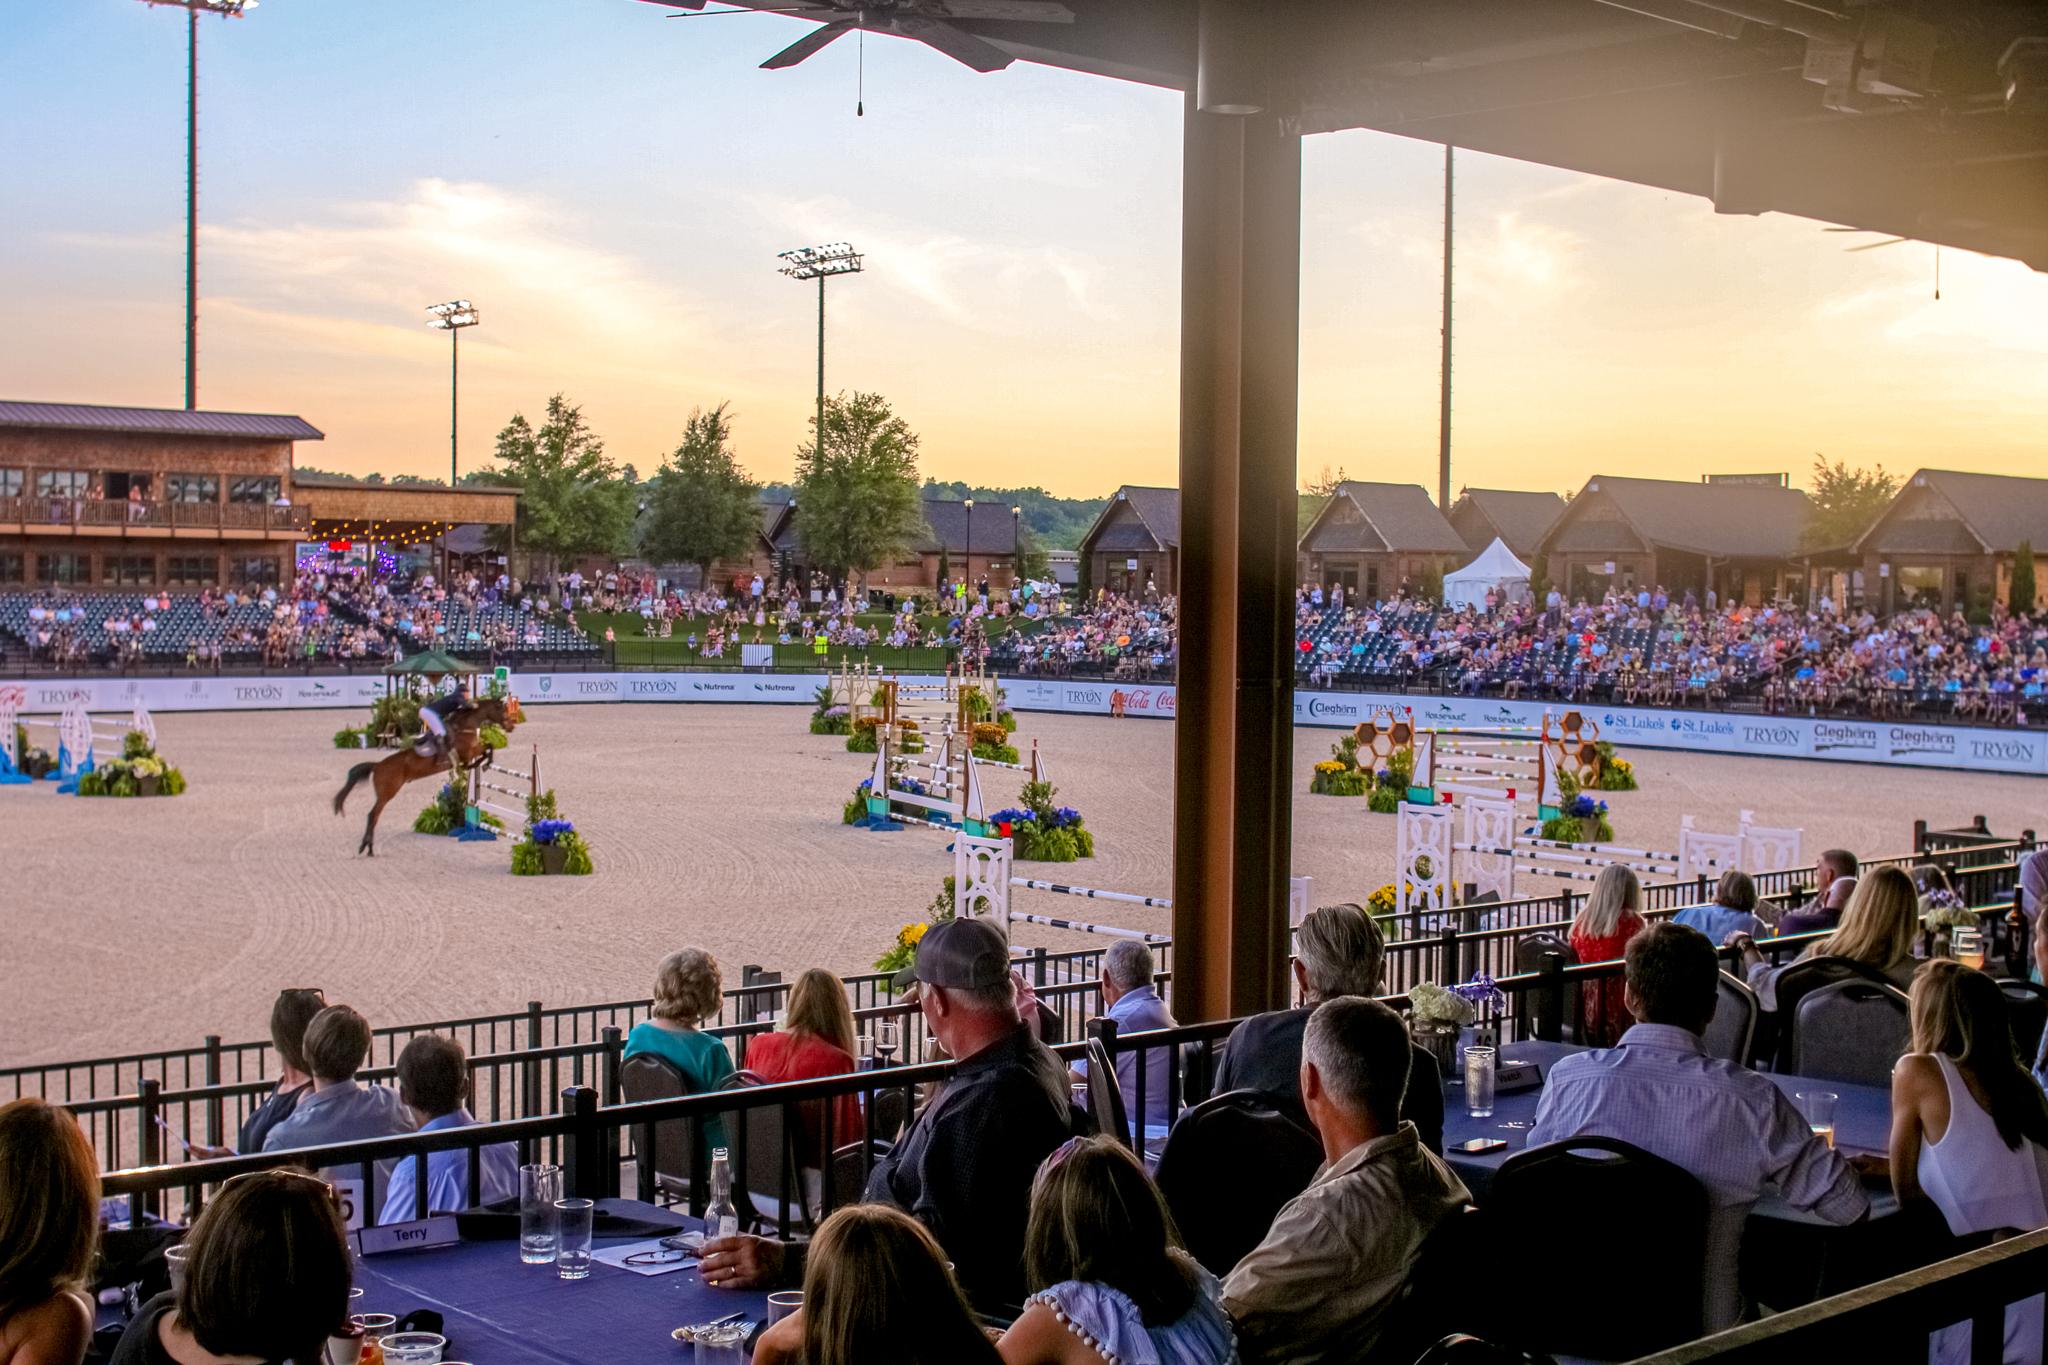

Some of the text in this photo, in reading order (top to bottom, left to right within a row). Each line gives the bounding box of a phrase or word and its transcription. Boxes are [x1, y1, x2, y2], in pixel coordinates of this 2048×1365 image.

[234, 685, 282, 699] TRYON
[577, 680, 617, 692] TRYON
[630, 680, 677, 692] TRYON
[704, 683, 735, 691] Nutrena
[764, 684, 796, 692] Nutrena
[38, 688, 92, 703] TRYON
[1066, 689, 1102, 702] TRYON
[1615, 715, 1665, 730] St. Luke's
[1682, 719, 1735, 735] St. Luke's
[1743, 726, 1800, 744] TRYON
[1970, 740, 2035, 760] TRYON
[393, 1227, 428, 1242] Terry
